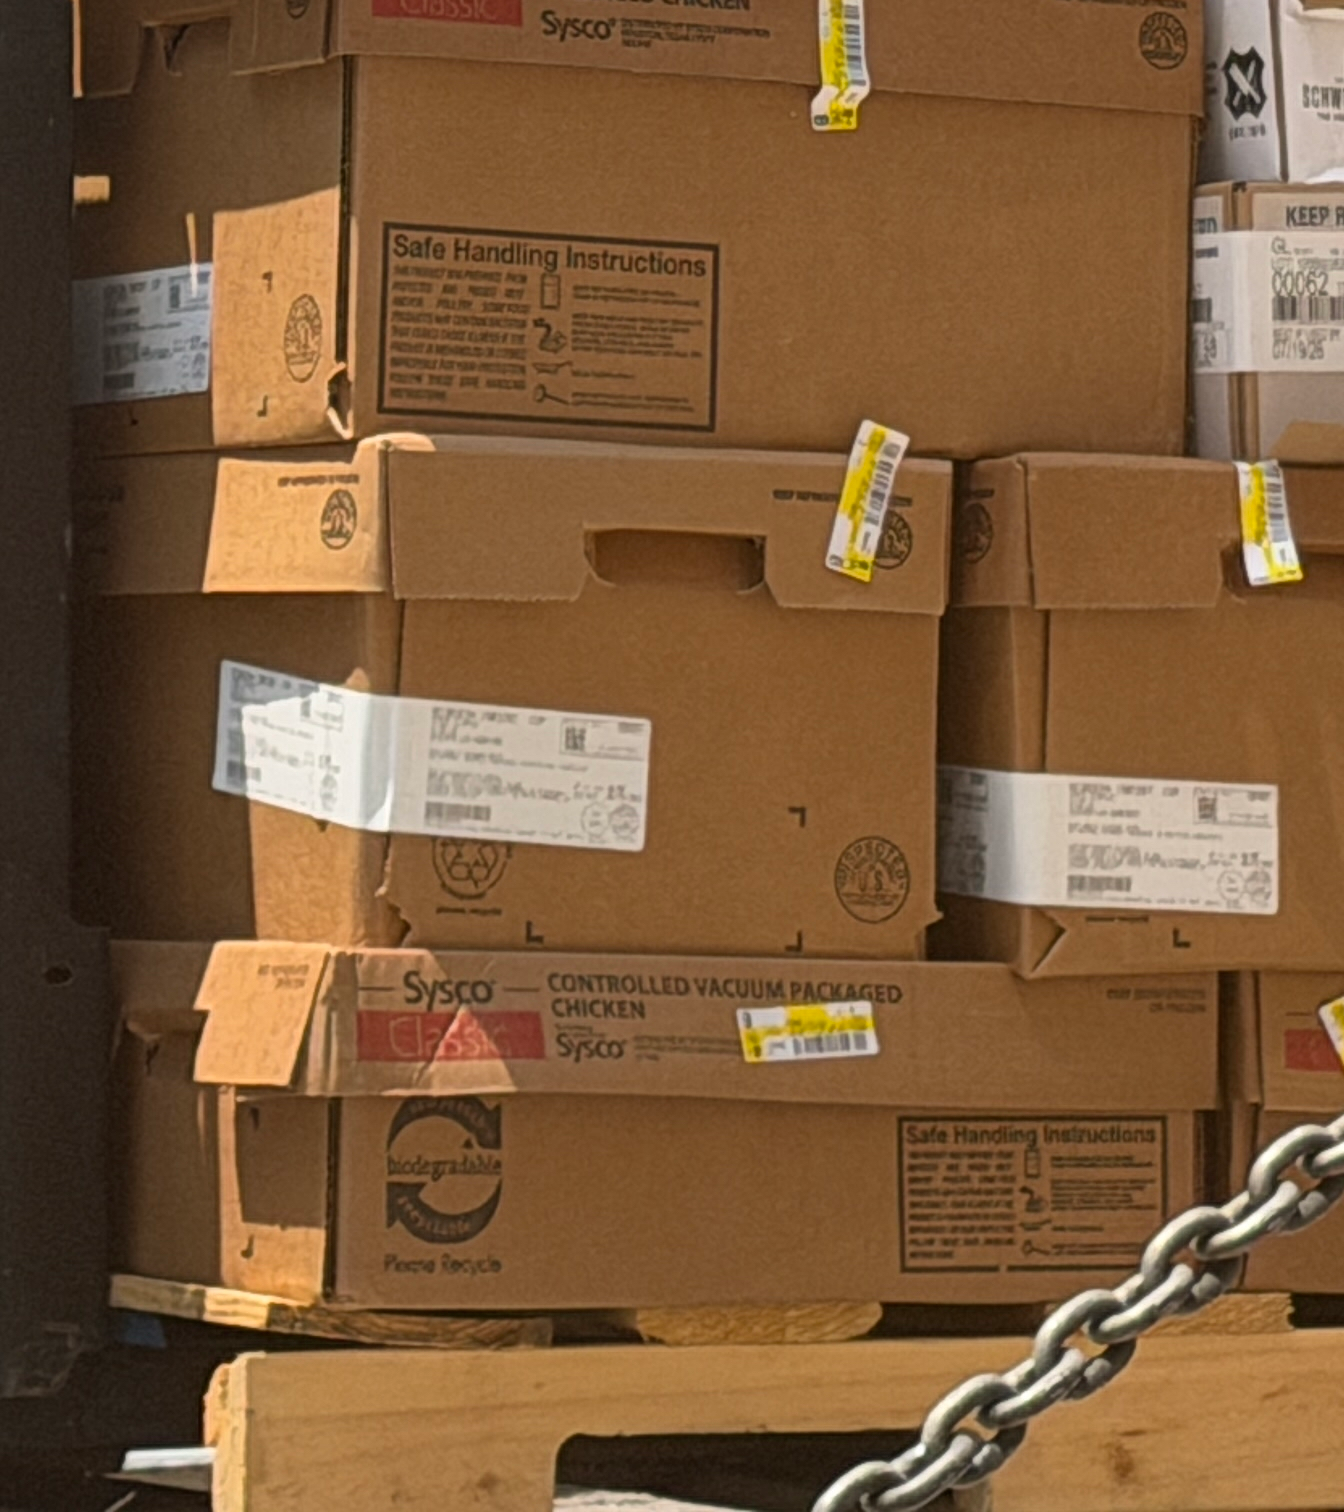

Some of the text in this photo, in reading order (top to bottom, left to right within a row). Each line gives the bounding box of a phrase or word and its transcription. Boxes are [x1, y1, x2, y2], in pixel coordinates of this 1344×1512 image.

[1286, 204, 1330, 228] KEEP
[392, 233, 707, 278] Safe Handling Instructions
[403, 970, 496, 1013] Sysco
[547, 971, 904, 1006] CONTROLLED VACUUM PACKAGED
[551, 998, 646, 1020] CHICKEN
[906, 1122, 1156, 1149] Safe Handling Instructions
[441, 1252, 503, 1277] Recycle
